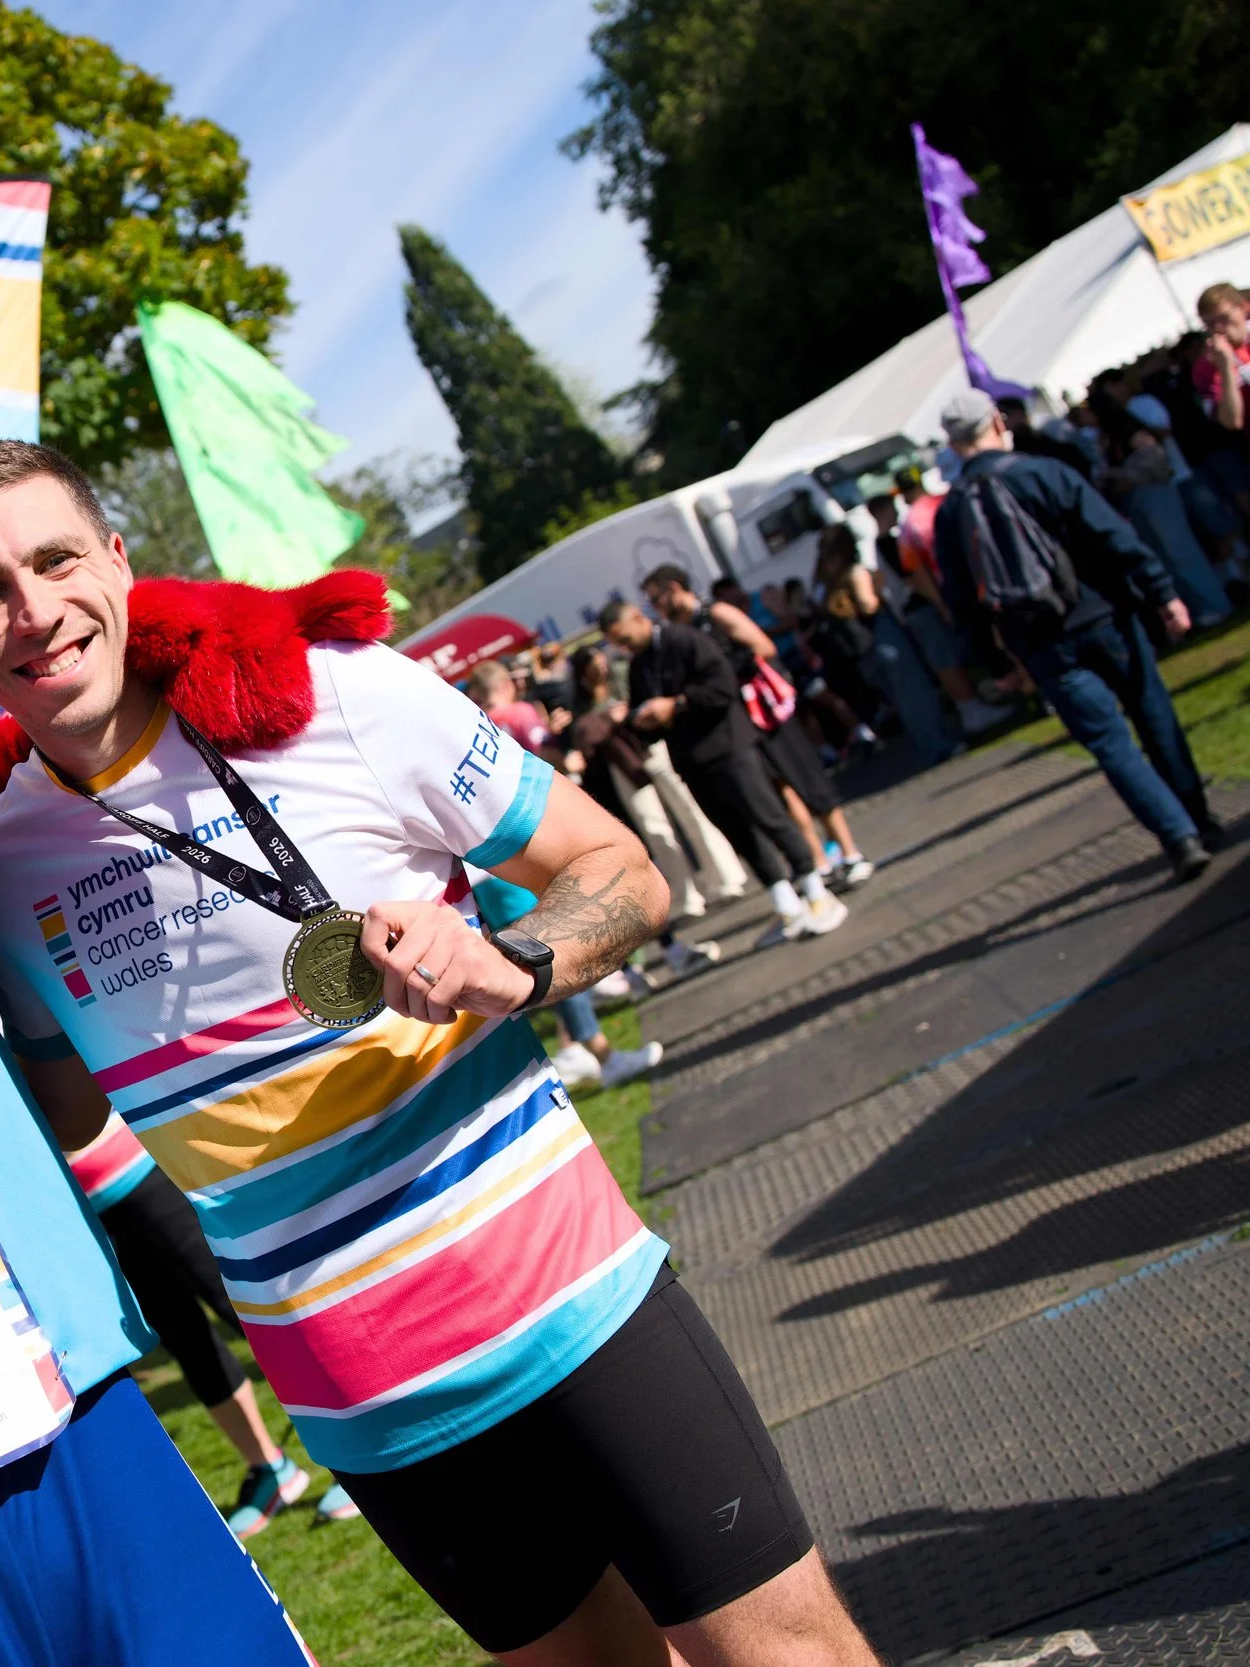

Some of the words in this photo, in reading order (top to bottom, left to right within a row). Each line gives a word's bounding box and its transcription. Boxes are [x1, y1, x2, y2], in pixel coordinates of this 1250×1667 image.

[142, 821, 170, 840] HALF
[181, 846, 212, 864] 2026
[268, 837, 294, 867] 2026
[77, 885, 155, 936] cymru
[87, 914, 168, 966] cancer
[100, 951, 174, 996] wales
